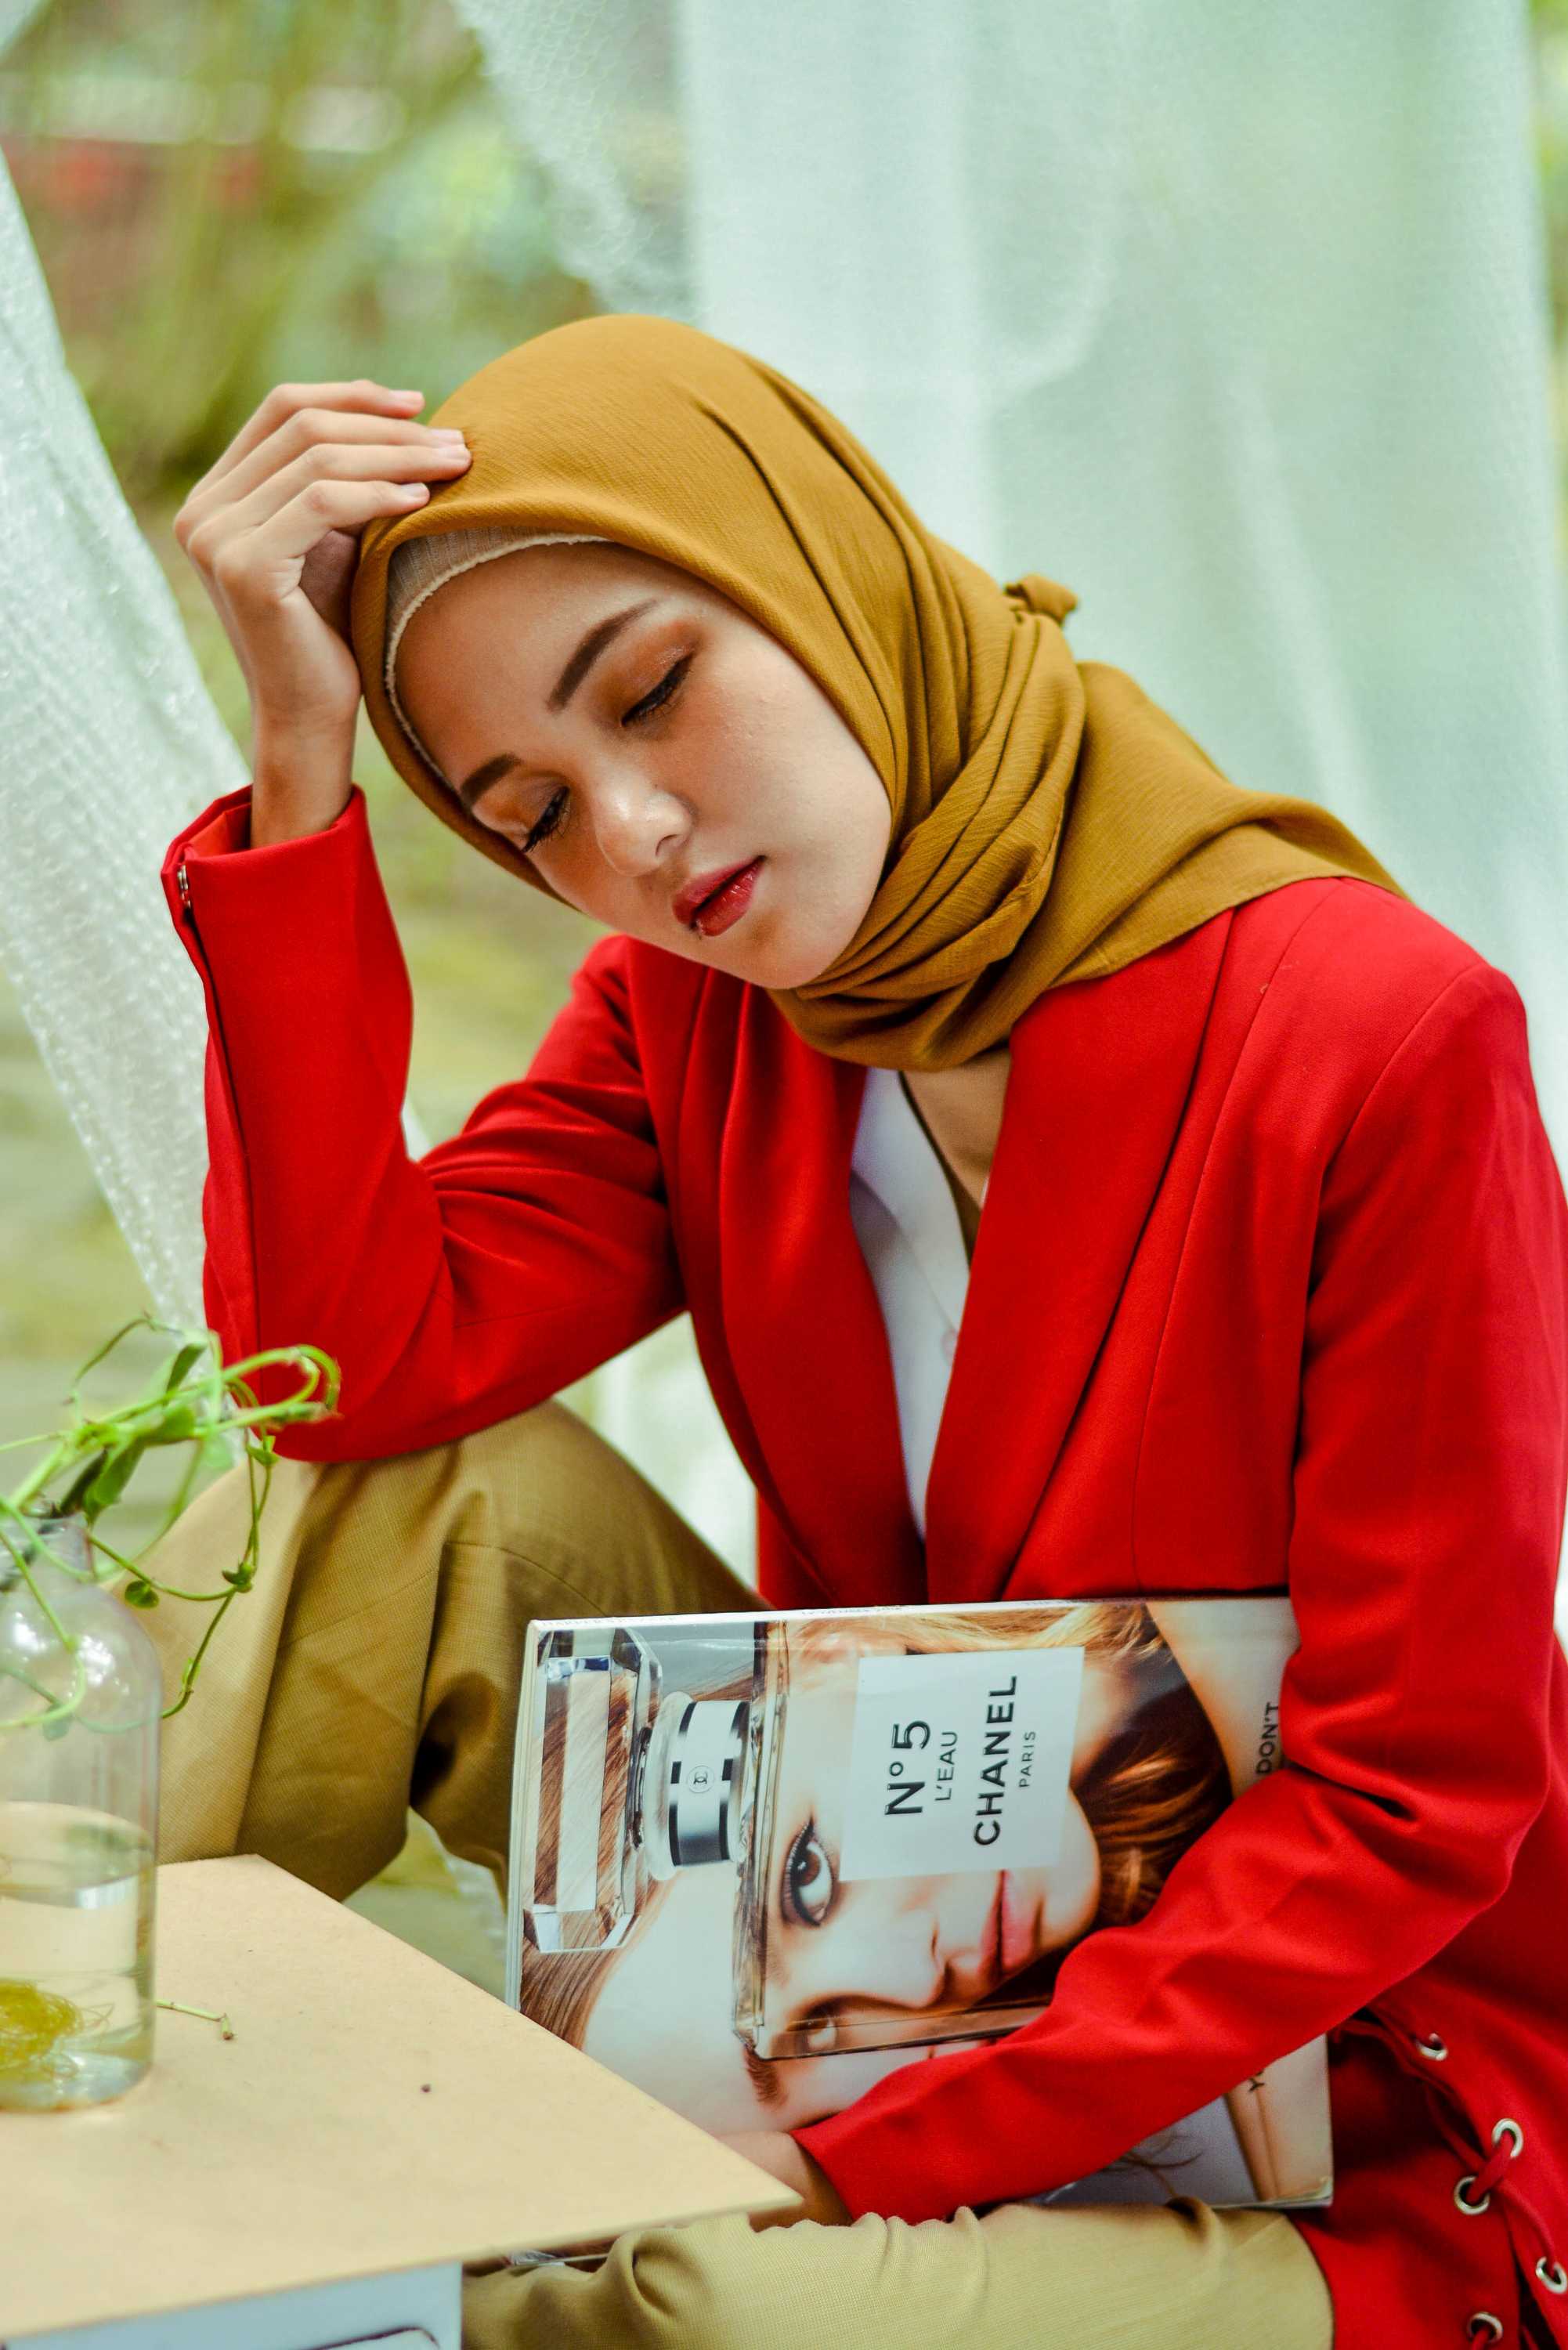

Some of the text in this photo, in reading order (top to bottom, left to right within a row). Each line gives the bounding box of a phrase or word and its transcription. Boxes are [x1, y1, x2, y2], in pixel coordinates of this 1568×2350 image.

[934, 1731, 958, 1801] L'EAU
[974, 1676, 1017, 1846] CHANEL
[1019, 1731, 1036, 1788] PARIS
[1255, 1701, 1279, 1774] DON'T
